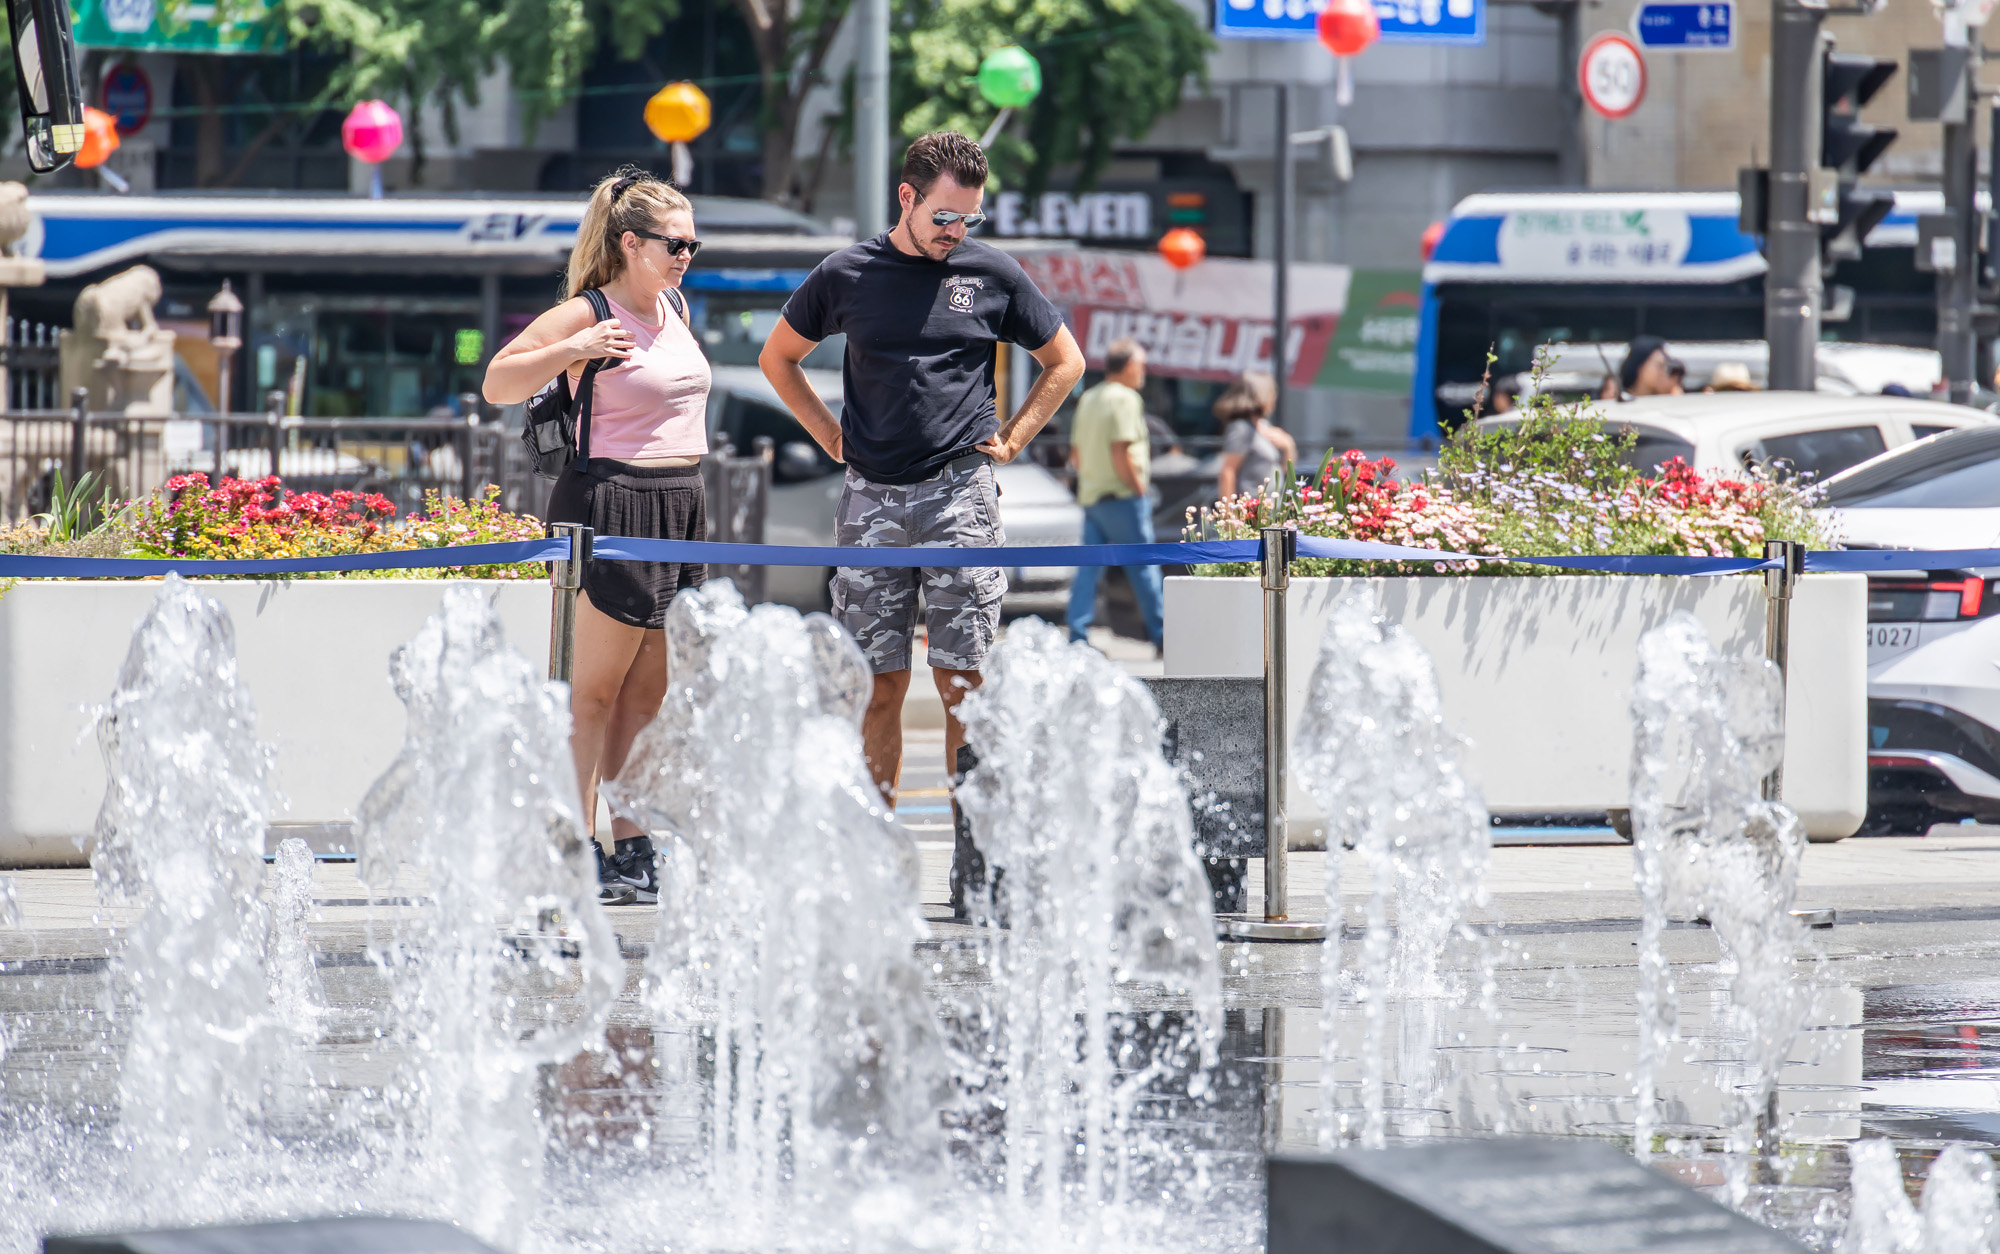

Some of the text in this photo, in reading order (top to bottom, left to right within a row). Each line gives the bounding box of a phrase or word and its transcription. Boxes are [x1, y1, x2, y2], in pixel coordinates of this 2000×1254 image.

[1597, 58, 1630, 94] 50
[469, 212, 545, 241] EV
[954, 293, 970, 306] 66
